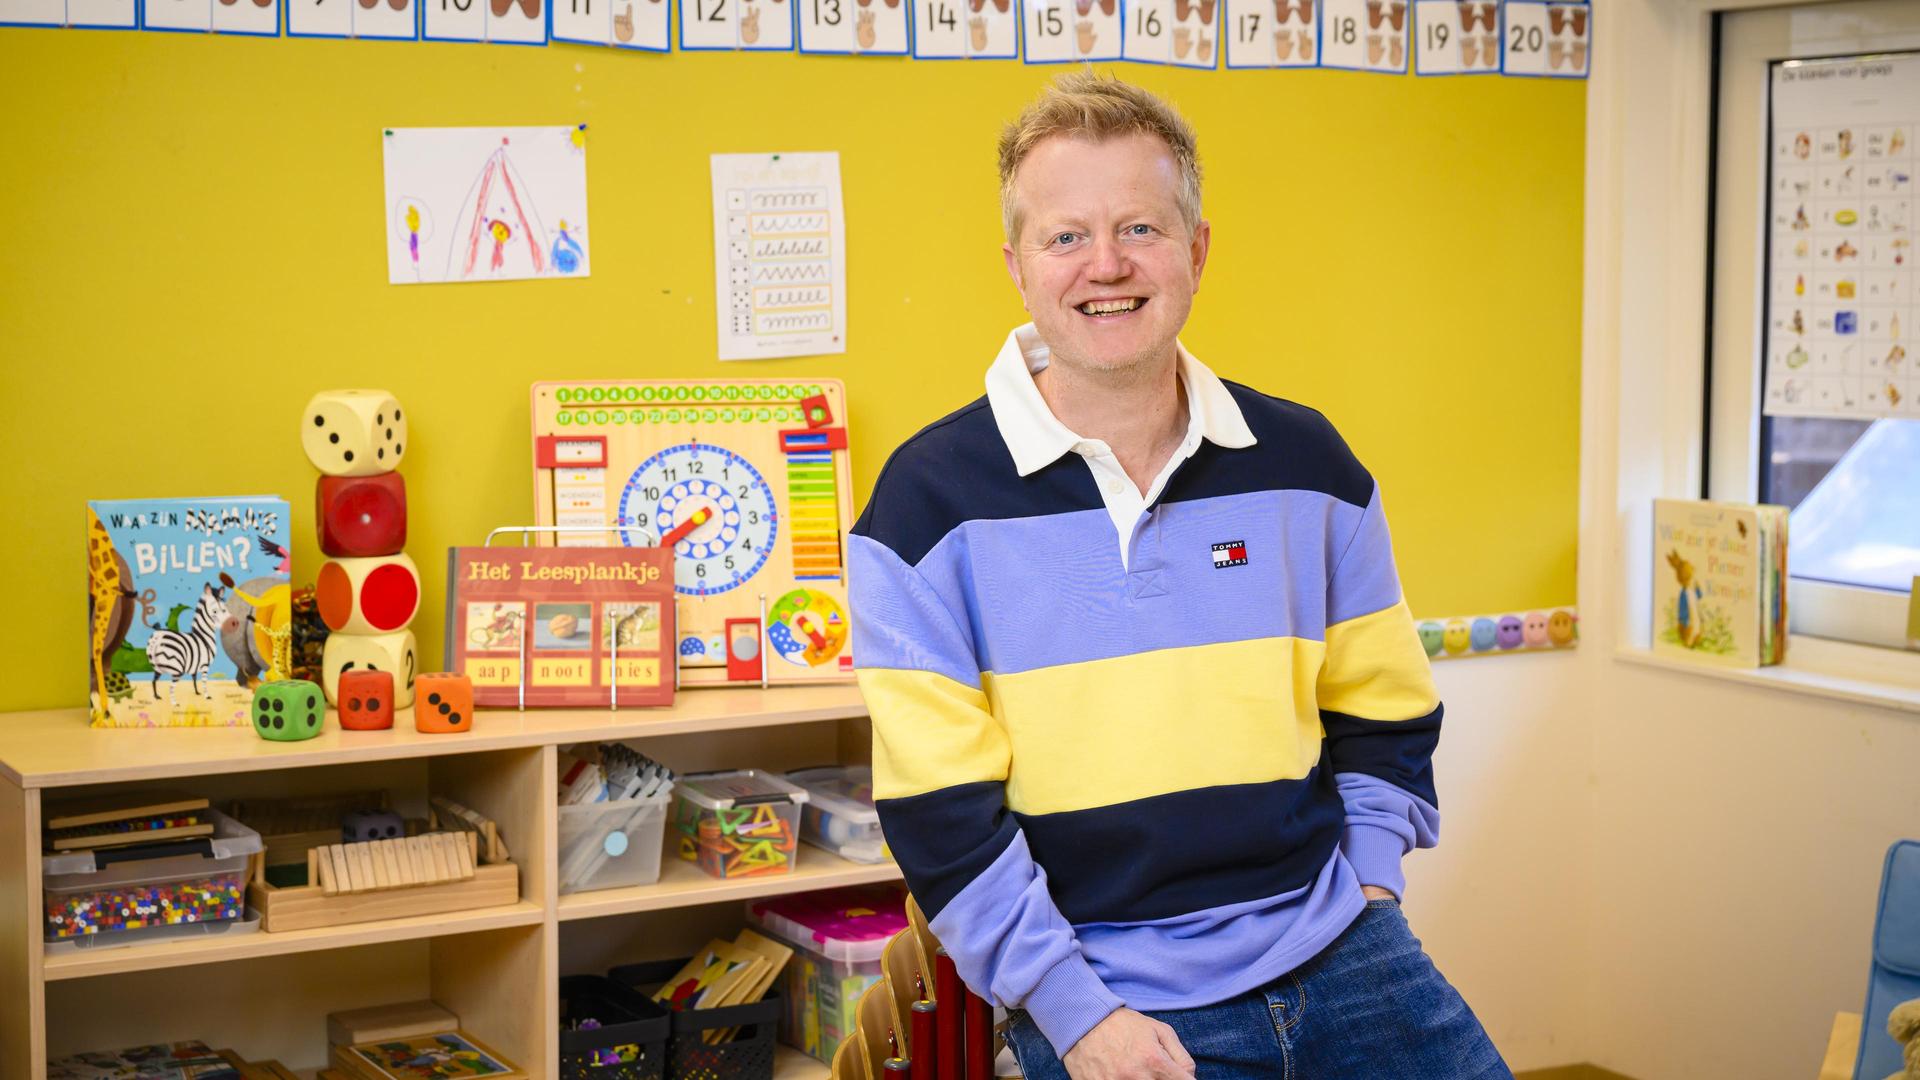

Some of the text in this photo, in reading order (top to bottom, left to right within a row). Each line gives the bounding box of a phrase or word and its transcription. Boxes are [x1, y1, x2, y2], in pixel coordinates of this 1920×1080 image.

[696, 0, 726, 21] 12
[813, 0, 842, 25] 13
[928, 3, 957, 31] 14
[1037, 8, 1063, 36] 15
[1136, 8, 1162, 37] 16
[1239, 14, 1261, 43] 17
[1333, 16, 1357, 44] 18
[1427, 23, 1450, 49] 19
[1510, 24, 1543, 52] 20
[662, 469, 677, 482] 11
[688, 461, 703, 474] 12
[722, 468, 729, 481] 1
[643, 487, 660, 501] 10
[739, 485, 748, 499] 2
[111, 513, 148, 529] WAAR
[638, 513, 648, 527] 9
[748, 511, 758, 524] 3
[742, 537, 751, 551] 4
[1213, 542, 1243, 551] TOMMY
[135, 536, 251, 575] BILLEN?
[725, 555, 735, 570] 5
[1216, 558, 1247, 567] JEANS
[468, 561, 661, 585] Het Leesplankje
[696, 564, 706, 578] 6
[405, 649, 415, 690] 2
